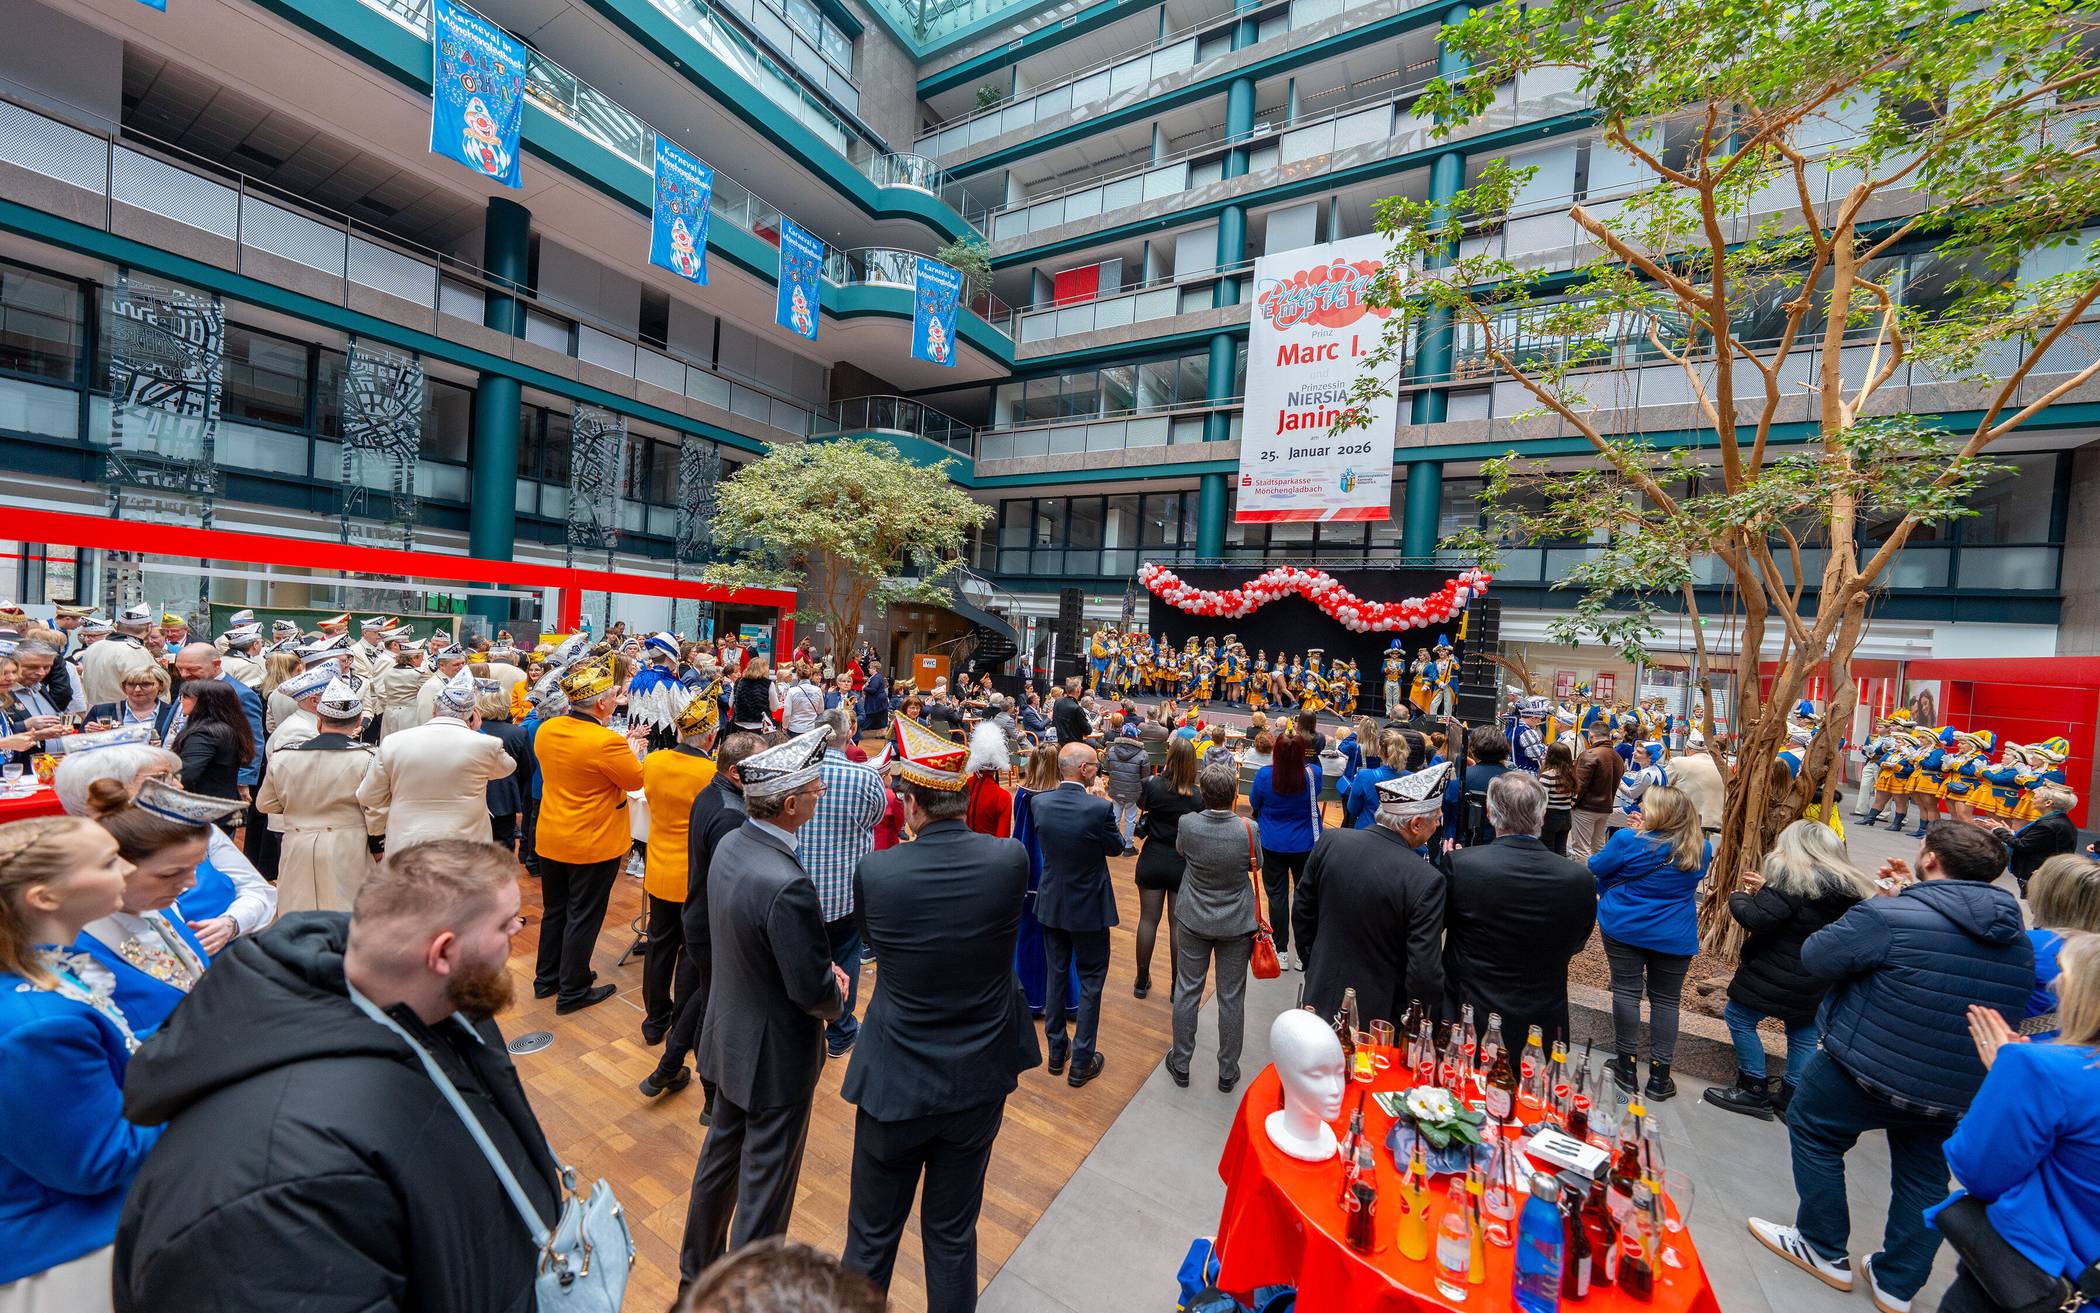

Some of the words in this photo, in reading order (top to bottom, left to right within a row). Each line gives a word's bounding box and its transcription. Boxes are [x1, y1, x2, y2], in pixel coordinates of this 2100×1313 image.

[448, 6, 500, 45] Karneval
[437, 10, 524, 70] Mönchengladbach
[664, 145, 697, 174] Karneval
[1311, 329, 1334, 339] Prinz
[1276, 342, 1340, 367] Marc
[1351, 334, 1367, 357] I.
[1301, 381, 1345, 392] Prinzessin
[1287, 389, 1348, 407] NIERSIA
[1260, 450, 1280, 462] 25.
[1288, 446, 1331, 460] Januar
[1337, 441, 1372, 455] 2026
[1254, 478, 1312, 488] Stadtsparkasse
[1254, 484, 1323, 496] Mönchengladbach
